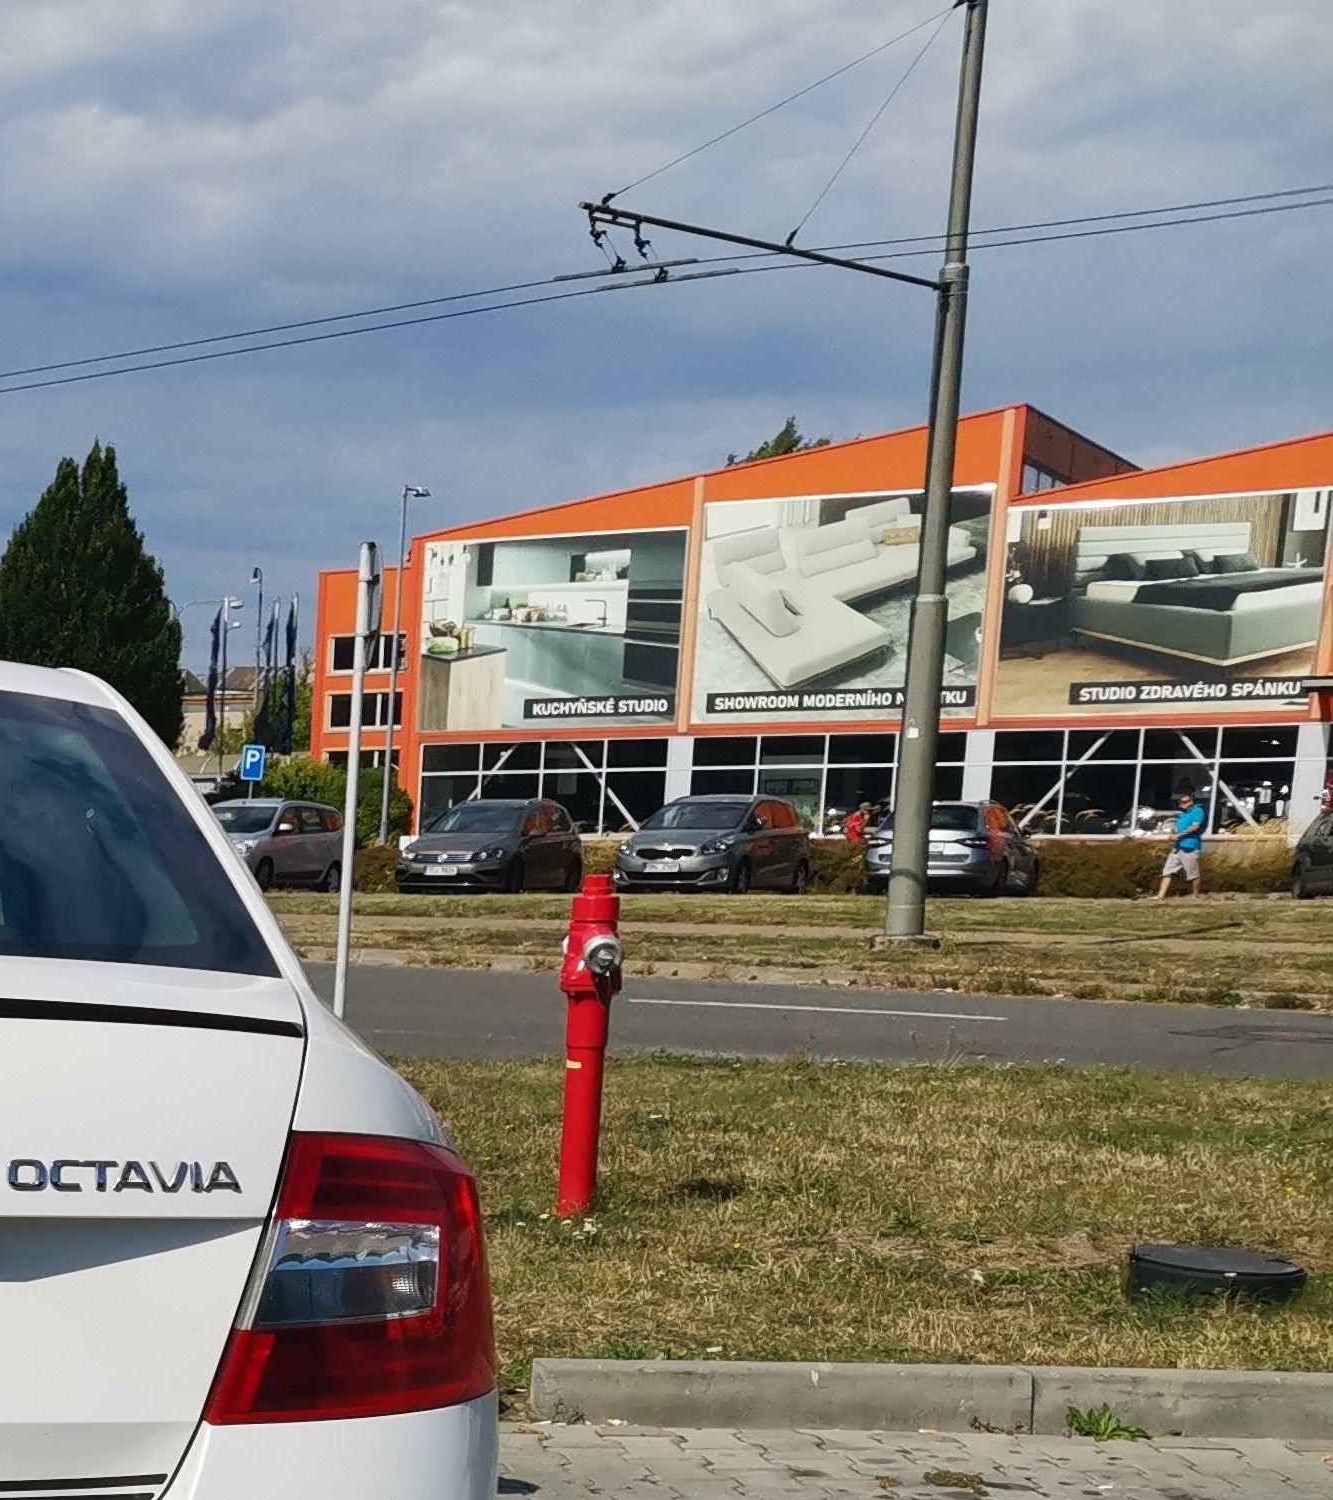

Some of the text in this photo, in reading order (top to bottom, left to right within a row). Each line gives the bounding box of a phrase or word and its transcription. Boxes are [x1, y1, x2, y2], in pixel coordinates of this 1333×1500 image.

[714, 690, 968, 711] SHOWROOM MODERNÍHO NTKU
[1079, 678, 1302, 702] STUDIO ZDRAVÉHO SPÁNKU
[532, 697, 669, 715] KUCHYŇSKÉ STUDIO
[246, 751, 260, 769] P
[6, 1158, 244, 1194] OCTAVIA
